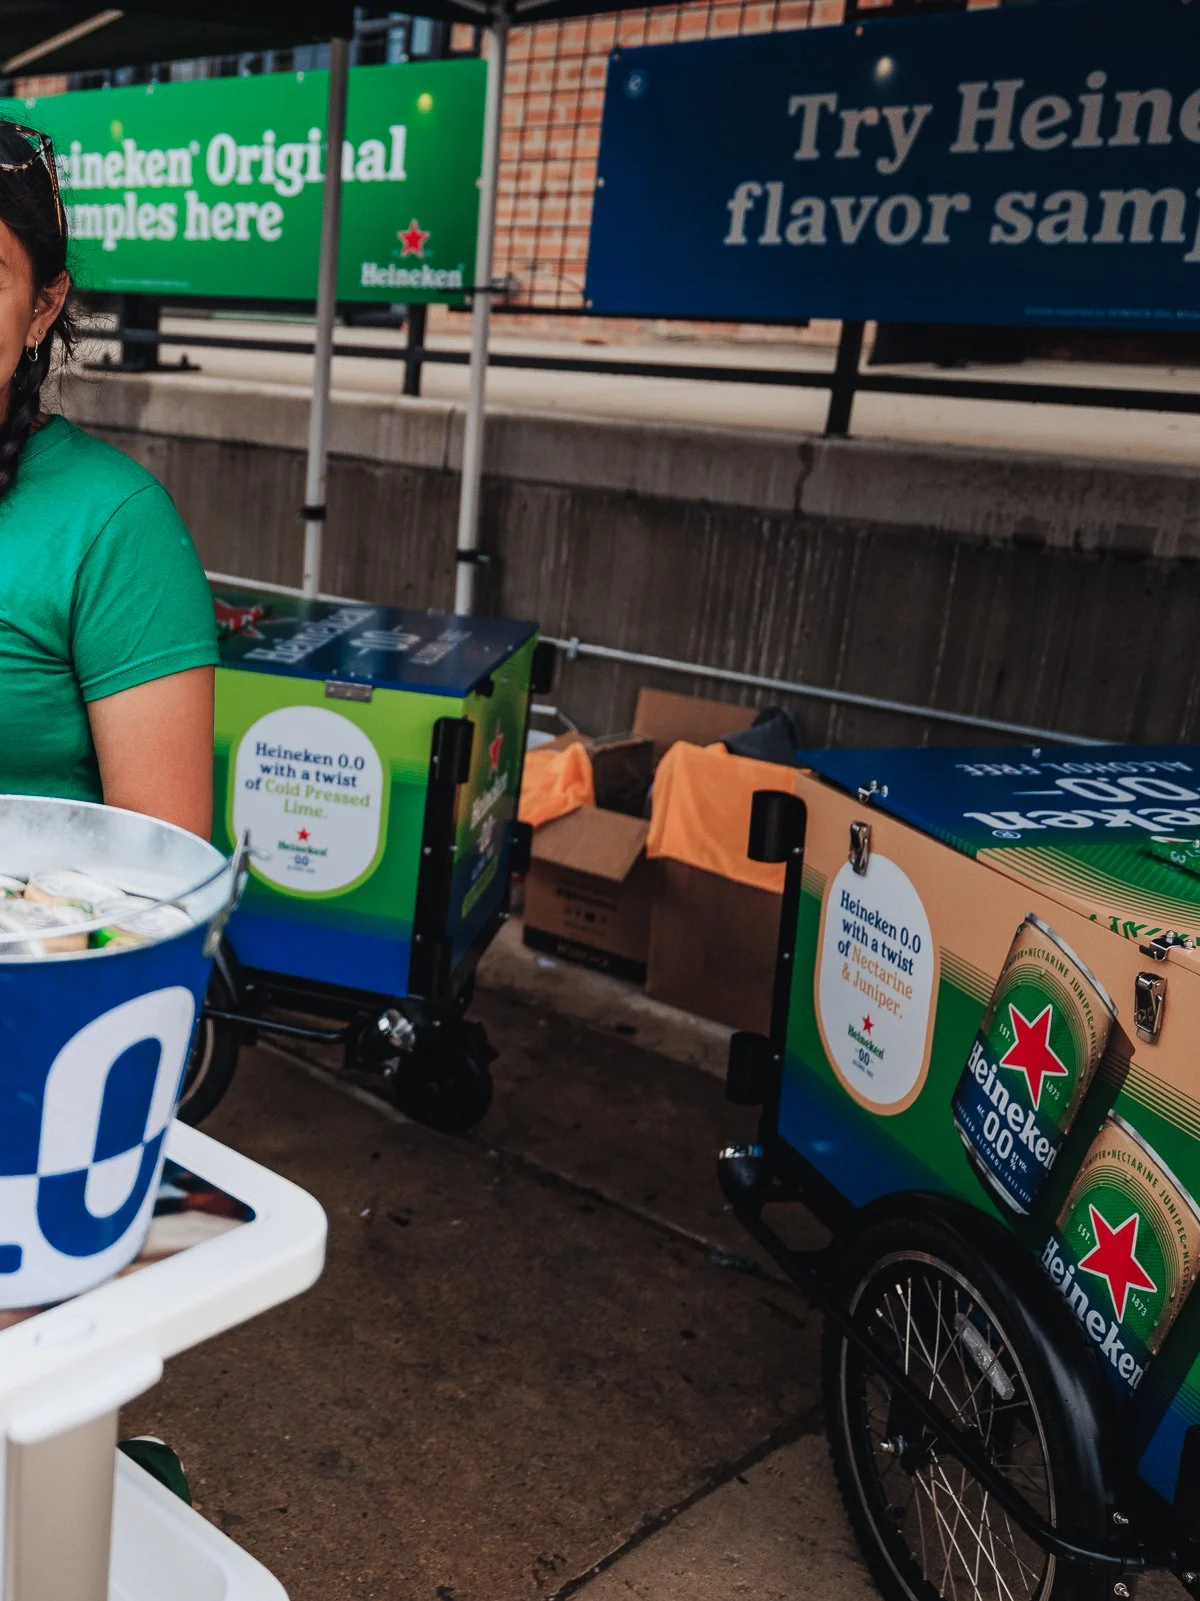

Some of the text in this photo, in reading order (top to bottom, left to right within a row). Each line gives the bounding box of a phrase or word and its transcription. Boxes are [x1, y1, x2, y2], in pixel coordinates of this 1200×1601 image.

[787, 92, 934, 174] Try
[56, 138, 194, 189] eineken
[67, 190, 284, 252] mples here
[724, 181, 1200, 263] flavor sam
[362, 262, 462, 289] Heineken
[255, 741, 365, 771] Heineken 0.0
[260, 762, 357, 788] with a twist
[244, 777, 371, 808] of Cold Pressed
[283, 799, 328, 819] Lime.
[841, 889, 921, 954] Heineken 0.0
[842, 918, 914, 976] with a twist
[838, 940, 913, 1000] of Nectarine
[842, 962, 850, 982] &
[968, 1040, 1058, 1170] Heineken
[1046, 1080, 1060, 1101] 1873
[983, 1111, 1014, 1160] 0.0
[1112, 1149, 1159, 1189] NECTARINE
[1159, 1190, 1187, 1242] JUNIPER
[1078, 1223, 1147, 1317] EST. 1873
[1040, 1235, 1144, 1390] Heineken
